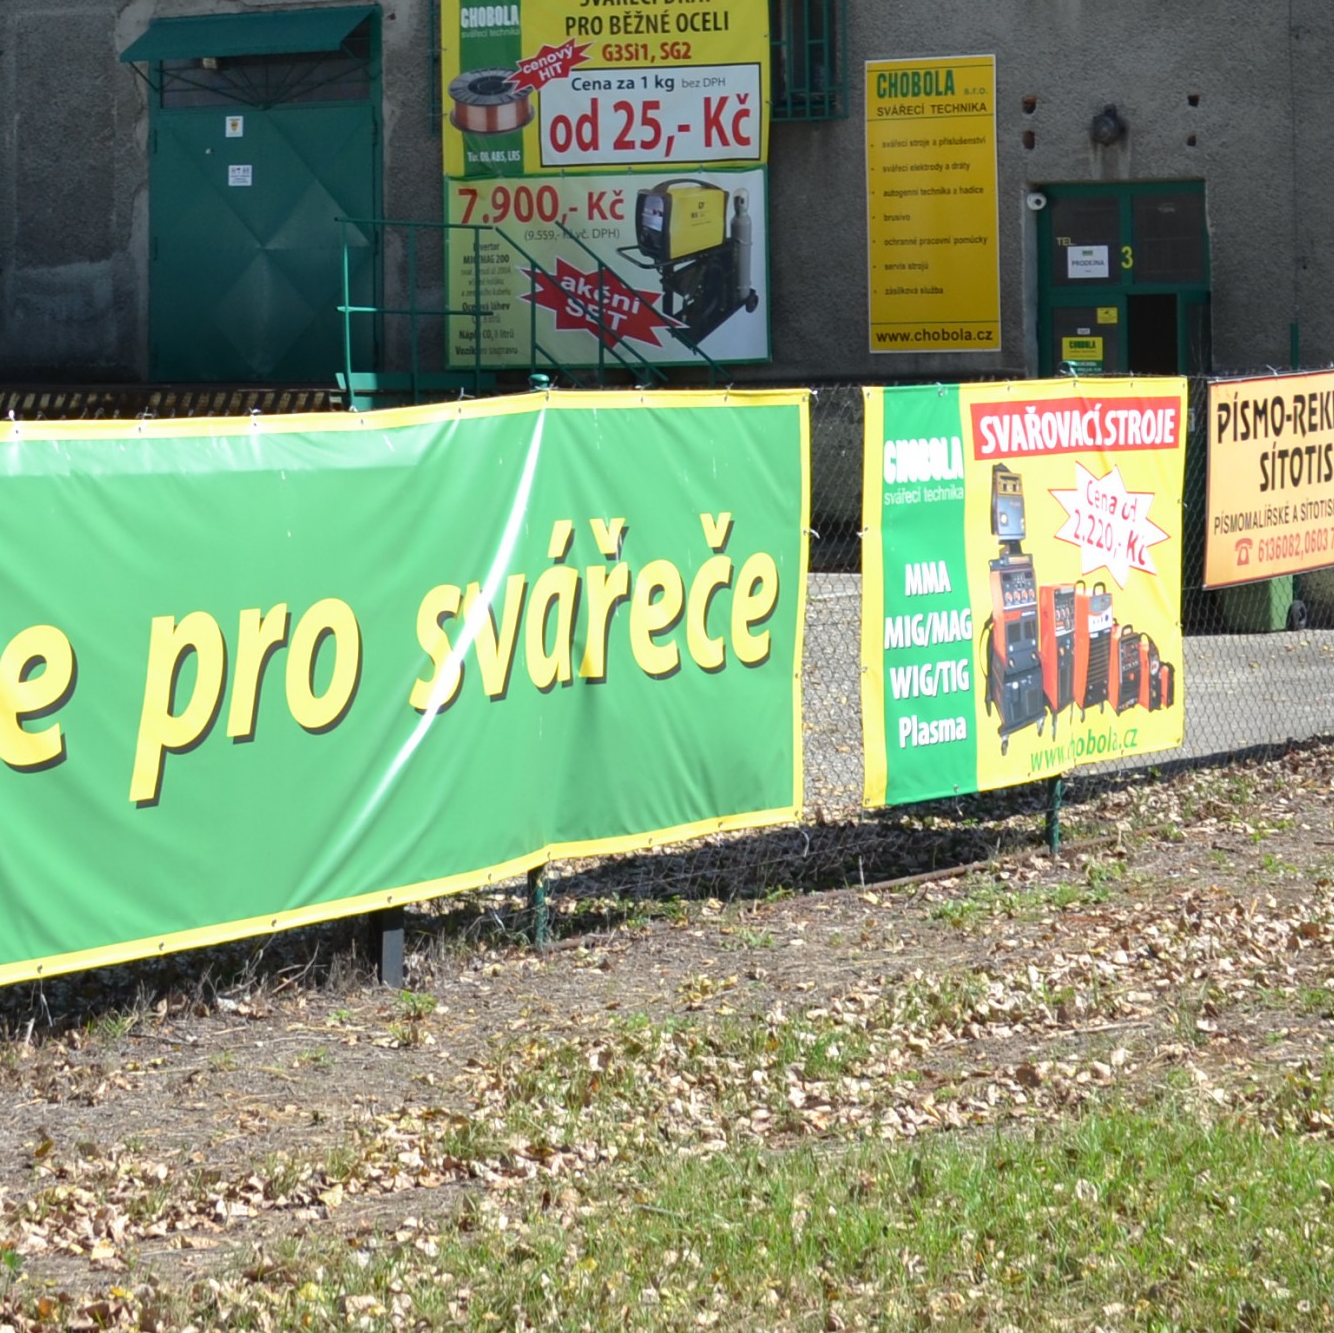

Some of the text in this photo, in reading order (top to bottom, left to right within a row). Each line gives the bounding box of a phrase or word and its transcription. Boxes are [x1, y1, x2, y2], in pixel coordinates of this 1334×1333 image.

[461, 5, 519, 28] CHOBOLA
[566, 9, 729, 36] PRO BĚŽNÉ OCELI
[522, 45, 575, 74] cenový
[602, 42, 691, 63] G3Si1, SG2
[539, 61, 563, 81] HIT
[571, 75, 726, 92] Cena za 1 kg bez DPH
[877, 70, 955, 98] CHOBOLA
[877, 102, 987, 116] SVÁŘECÍ TECHNIKA
[550, 93, 751, 158] od 25,- Kč
[459, 185, 625, 225] 7.900,- Kč
[592, 228, 620, 240] DPH)
[1072, 259, 1105, 267] PRODEJNA
[1121, 246, 1134, 268] 3
[876, 328, 993, 342] www.chobola.cz
[980, 404, 1176, 455] SVAŘOVACÍ STROJE
[924, 484, 963, 502] technika
[1086, 480, 1138, 522] Cena od
[1214, 501, 1290, 535] PÍSMOMALÍŘSKÉ
[1292, 505, 1299, 523] A
[905, 560, 952, 596] MMA
[884, 607, 972, 650] MIG/MAG
[130, 597, 361, 807] pro
[411, 512, 782, 713] svářeče
[890, 660, 970, 699] WIG/TIG
[899, 716, 967, 748] Plasma
[1030, 726, 1138, 772] www.hobola.cz
